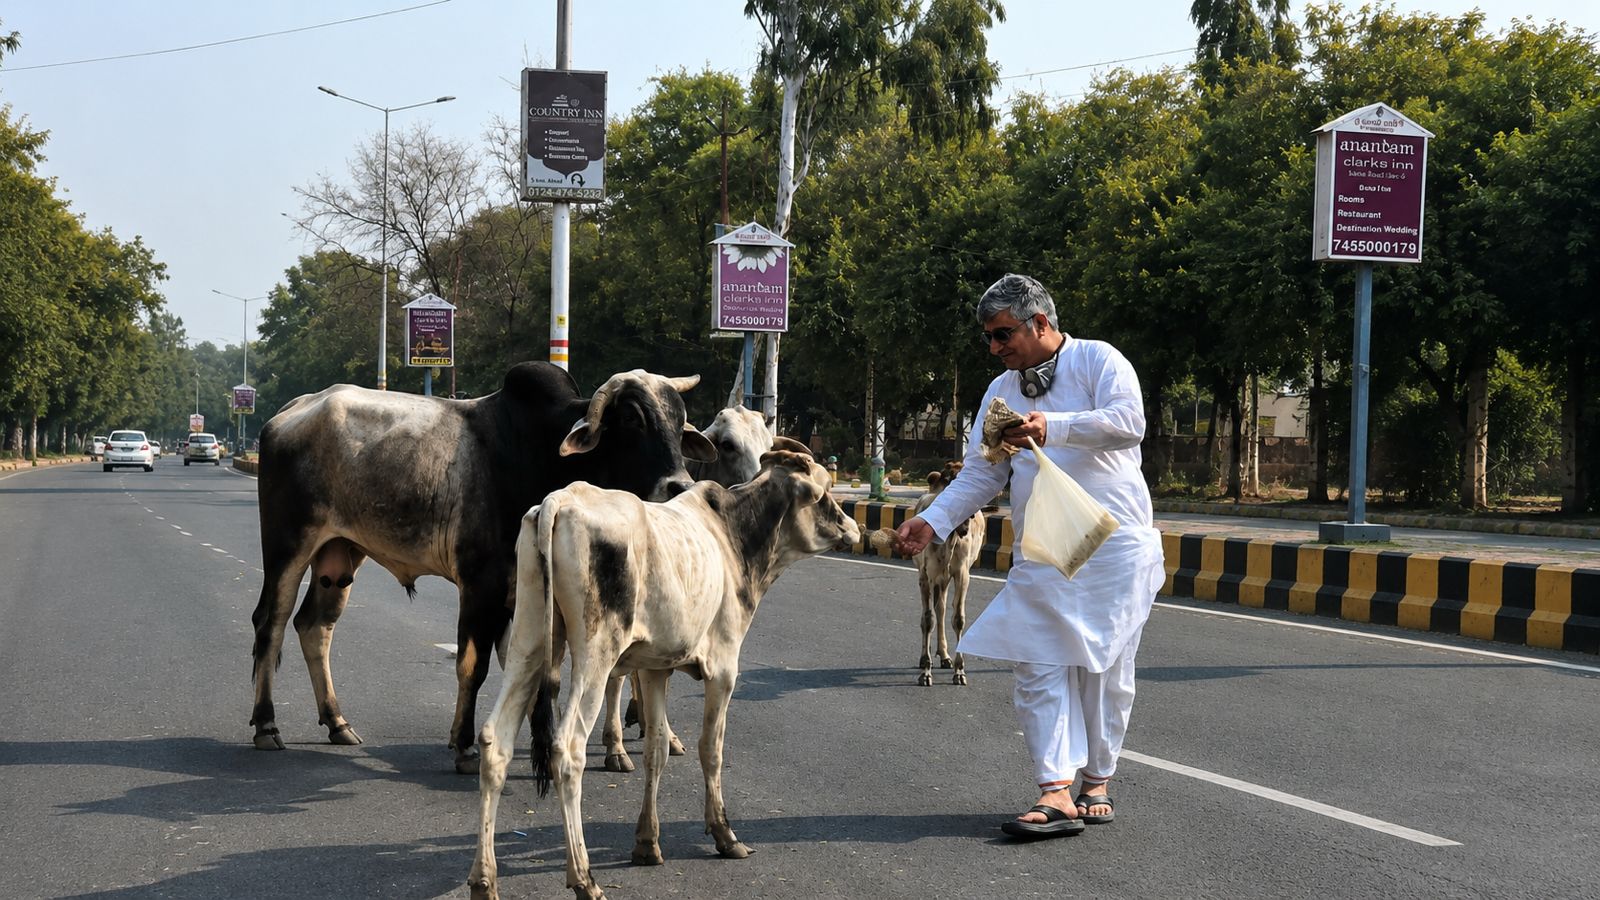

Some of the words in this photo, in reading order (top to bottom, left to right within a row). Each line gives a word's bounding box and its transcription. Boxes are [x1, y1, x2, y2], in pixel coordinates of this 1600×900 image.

[529, 107, 581, 118] COUNTRY
[584, 108, 603, 119] INN
[1343, 156, 1388, 169] clarks
[1392, 158, 1414, 170] inn
[1338, 194, 1365, 203] Rooms
[1337, 209, 1382, 219] Restaurant
[1336, 223, 1382, 233] Destination
[1383, 225, 1418, 236] Wedding
[1333, 239, 1417, 254] 7455000179
[722, 315, 784, 326] 7455000179
